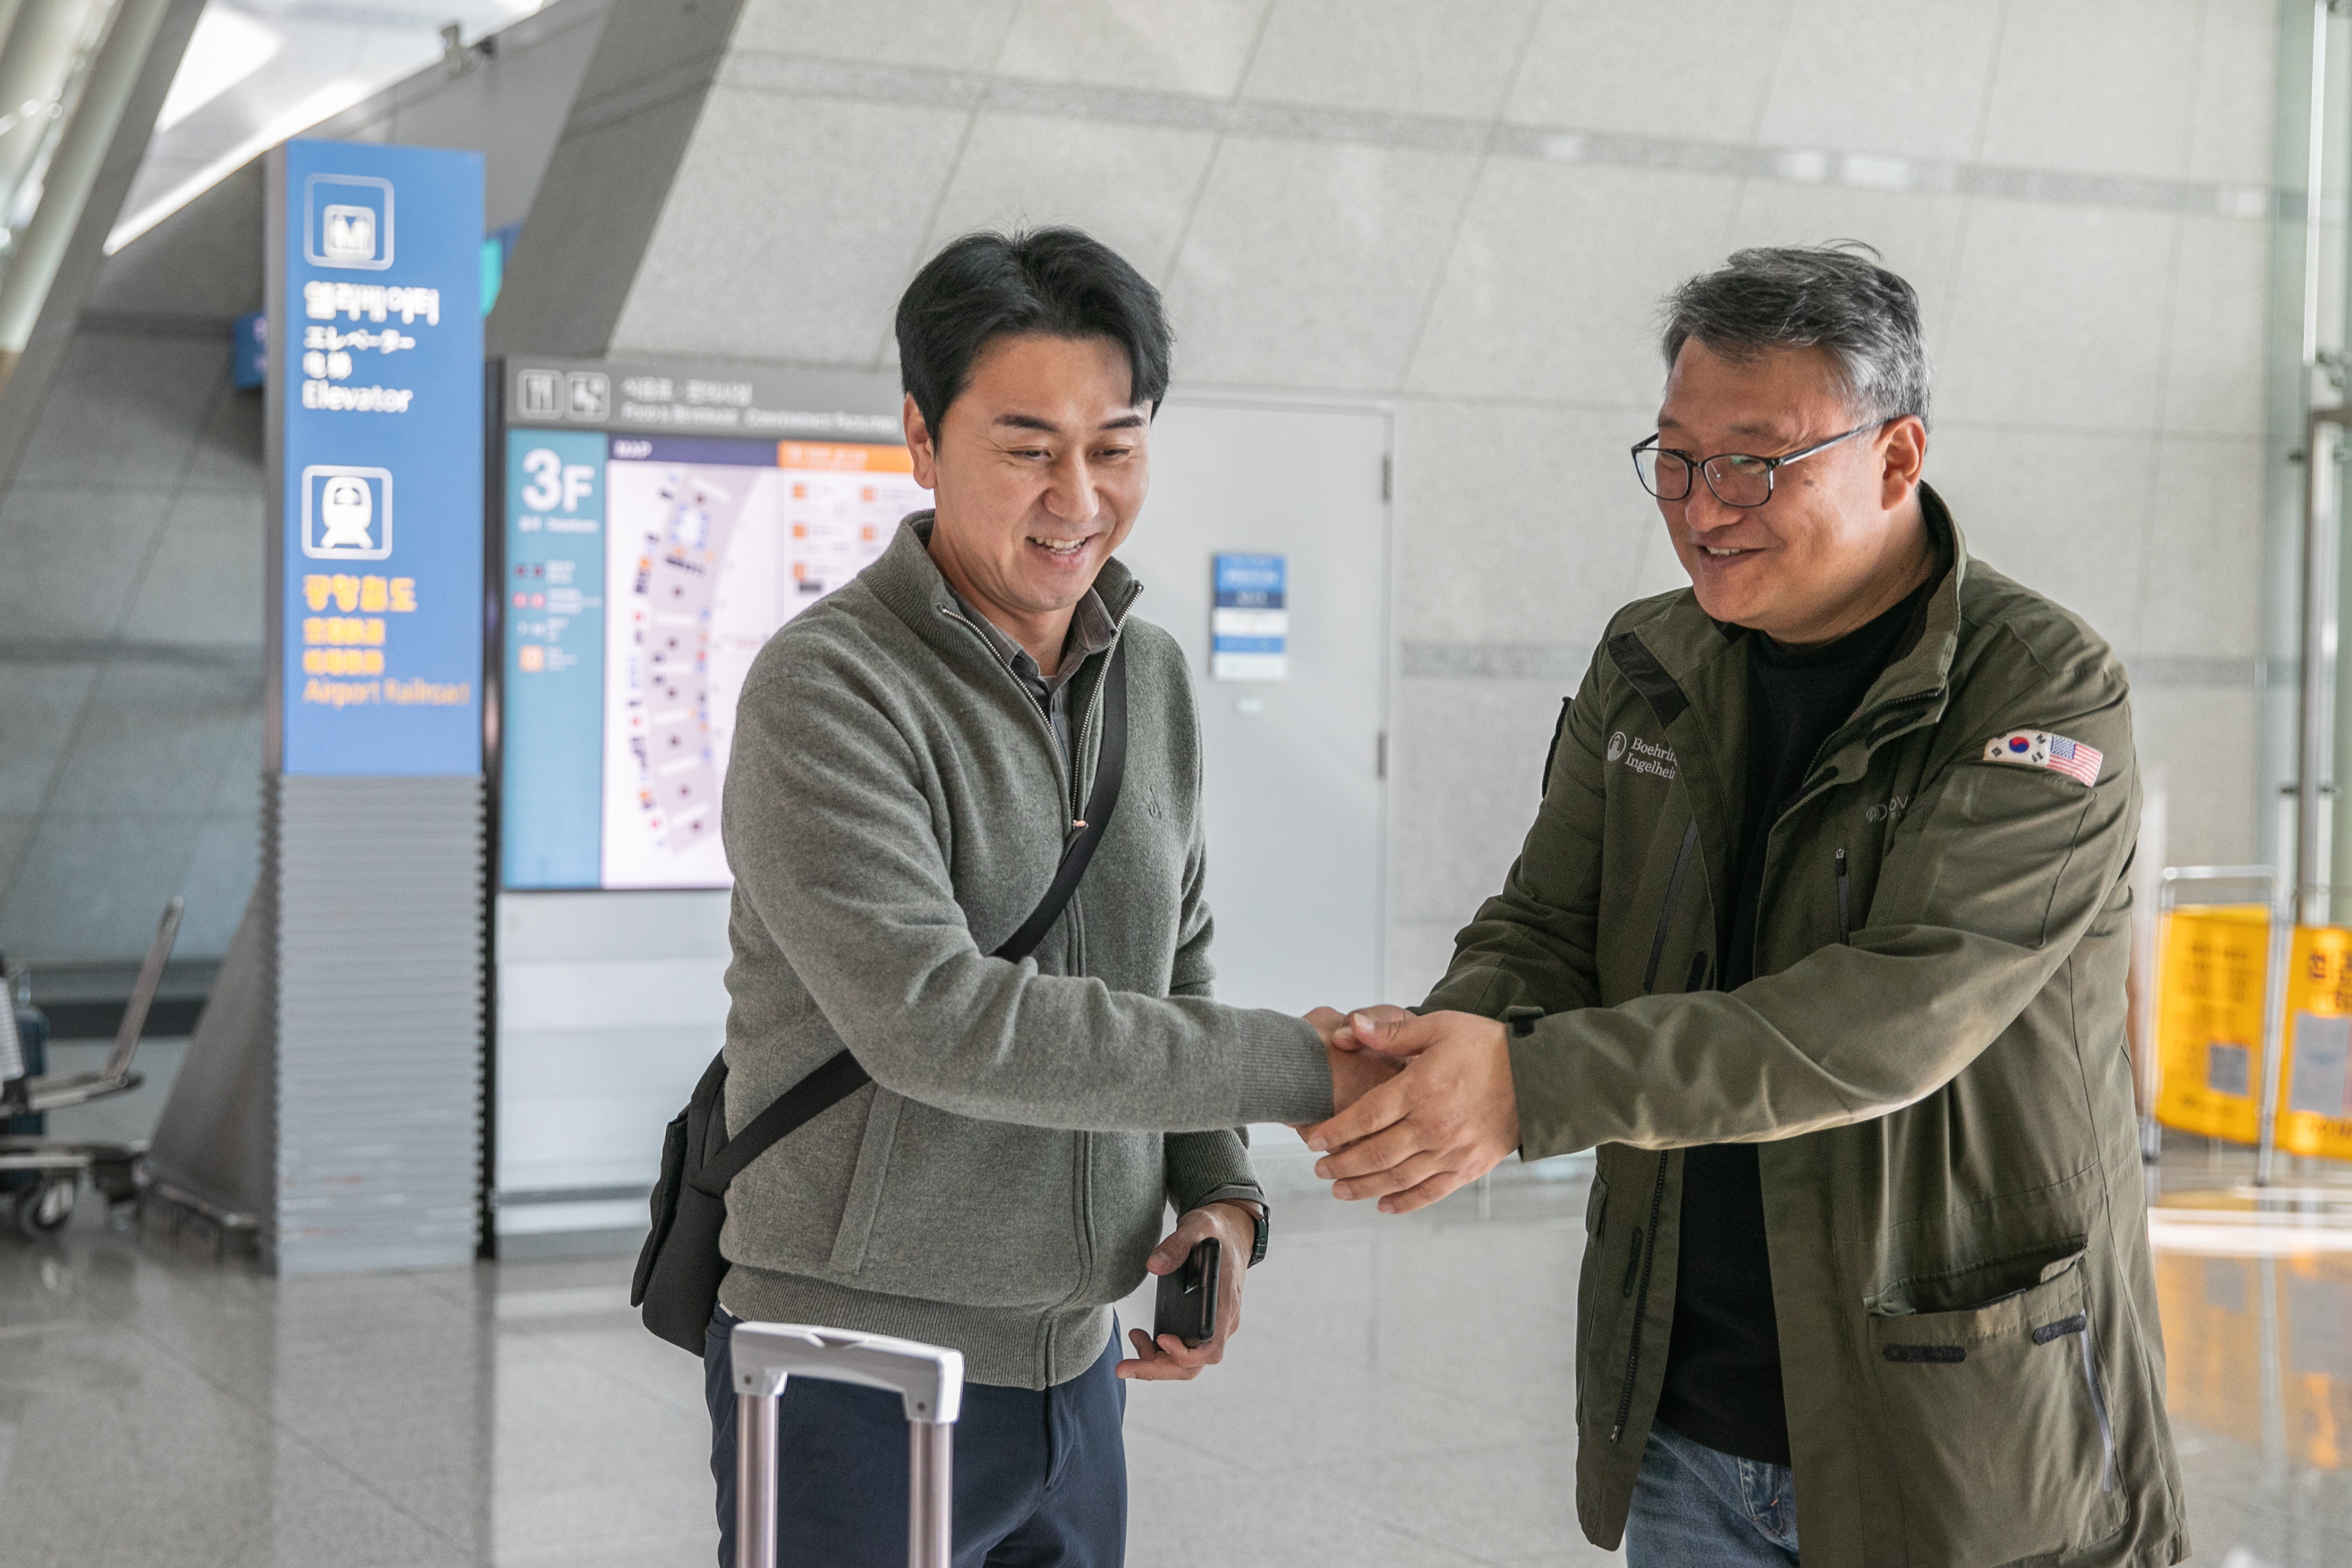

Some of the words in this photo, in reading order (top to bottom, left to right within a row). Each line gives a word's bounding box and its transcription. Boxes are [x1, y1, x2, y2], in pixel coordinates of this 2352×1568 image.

[303, 380, 413, 413] Elevator
[522, 448, 595, 513] 3F
[304, 677, 380, 709] Airport
[1624, 752, 1675, 780] Ingelhei
